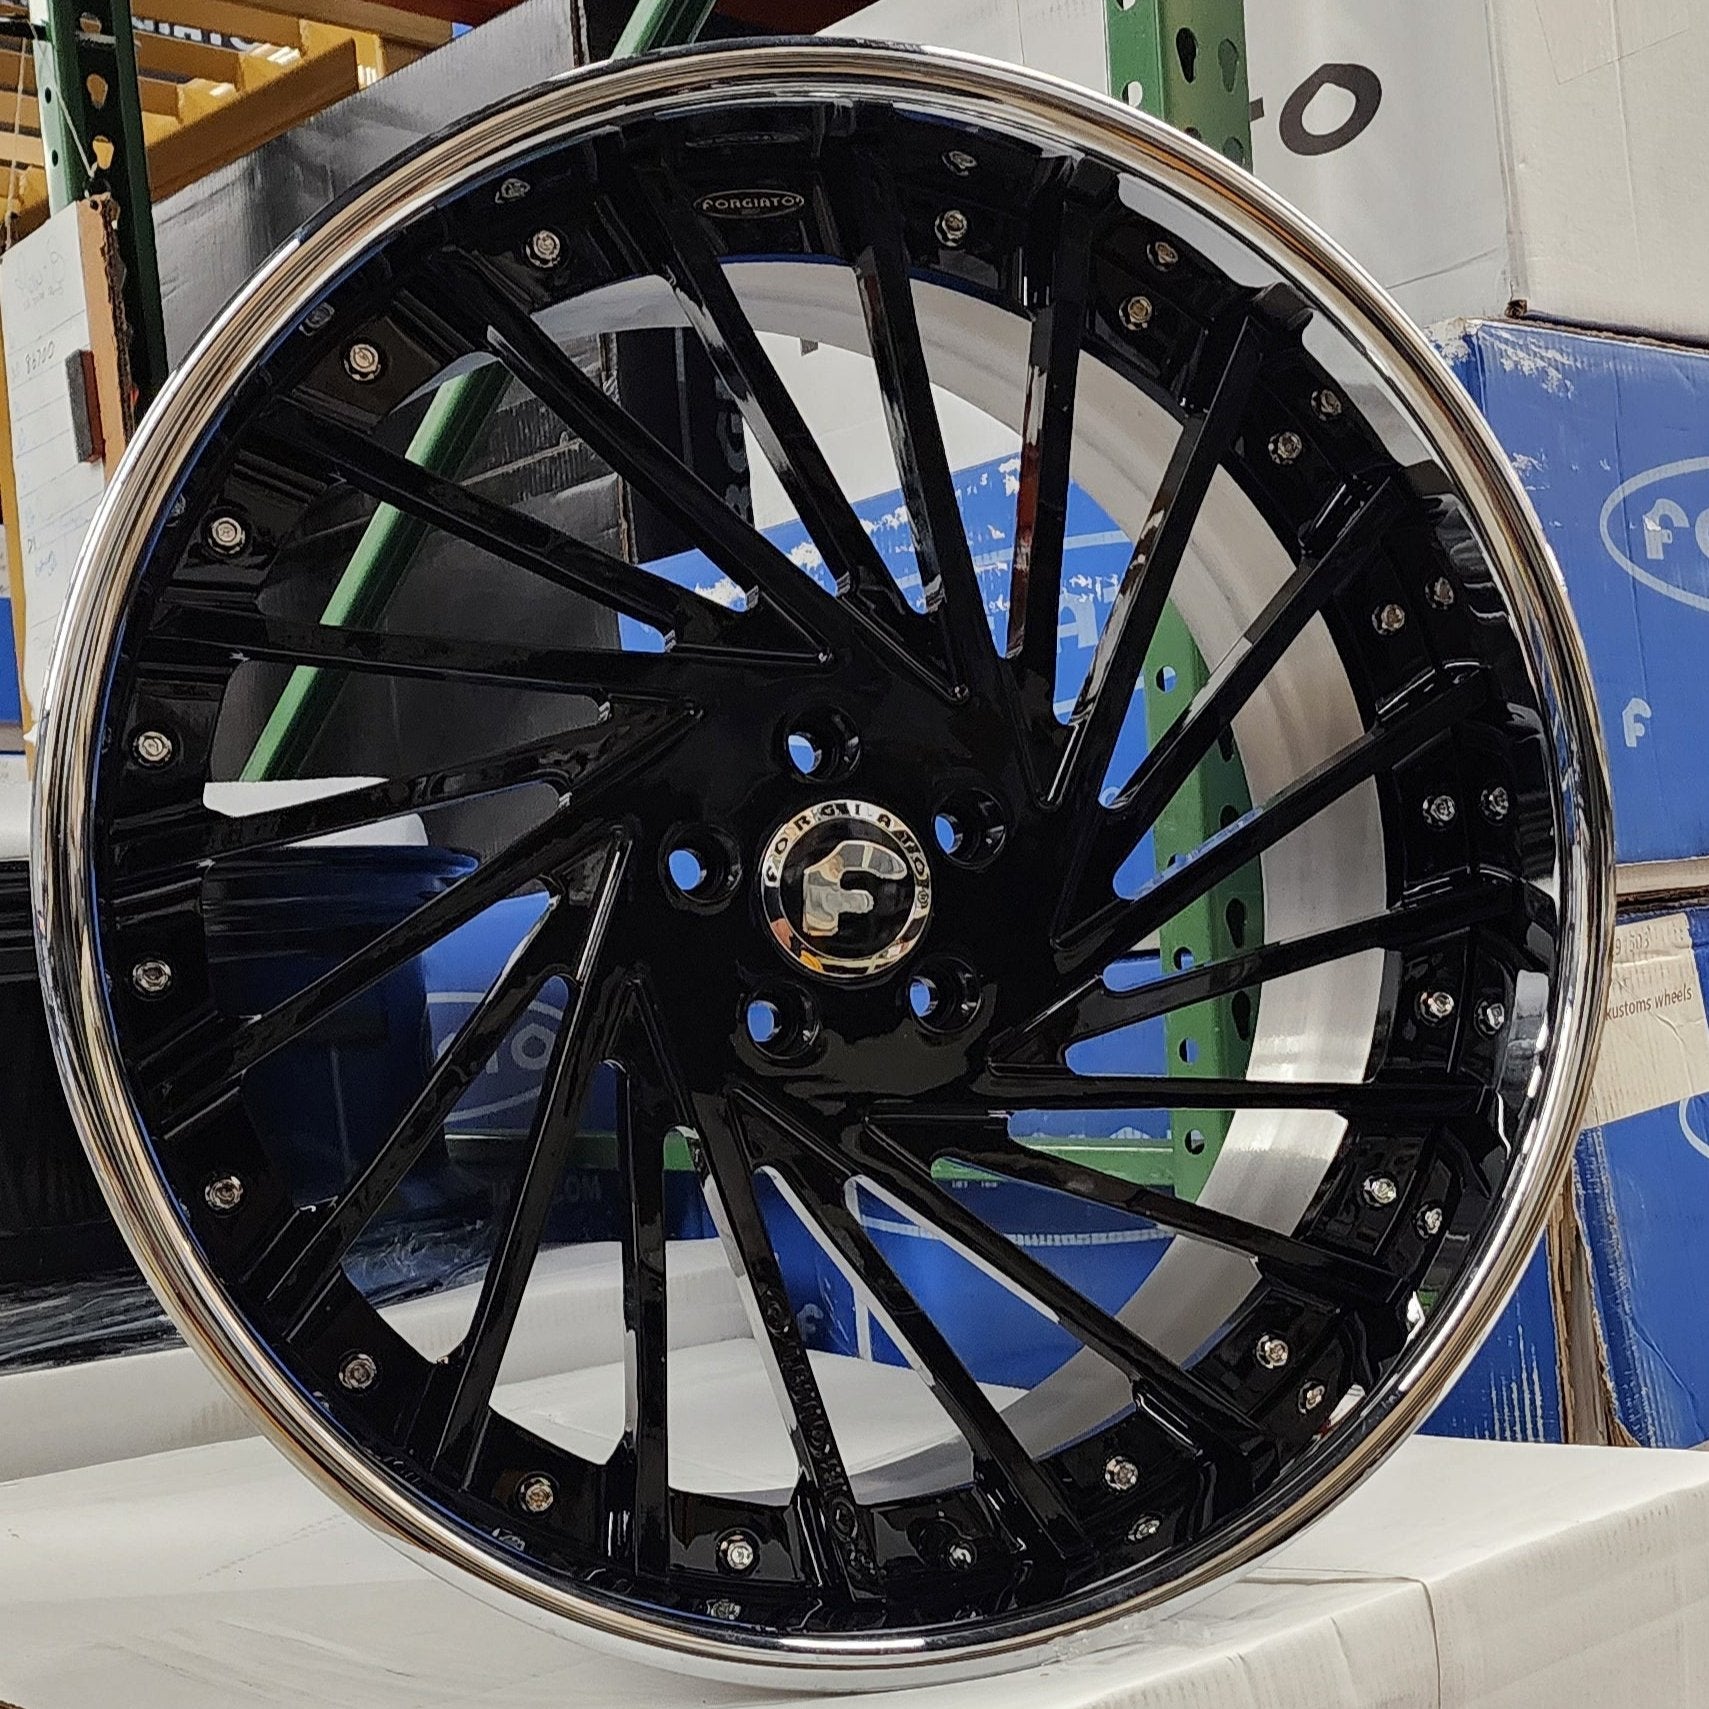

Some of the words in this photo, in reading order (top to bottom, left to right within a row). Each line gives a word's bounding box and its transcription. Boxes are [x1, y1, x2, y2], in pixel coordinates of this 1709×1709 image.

[702, 196, 795, 210] FORGIATO
[1606, 998, 1652, 1021] kustoms
[1655, 983, 1692, 1009] wheels
